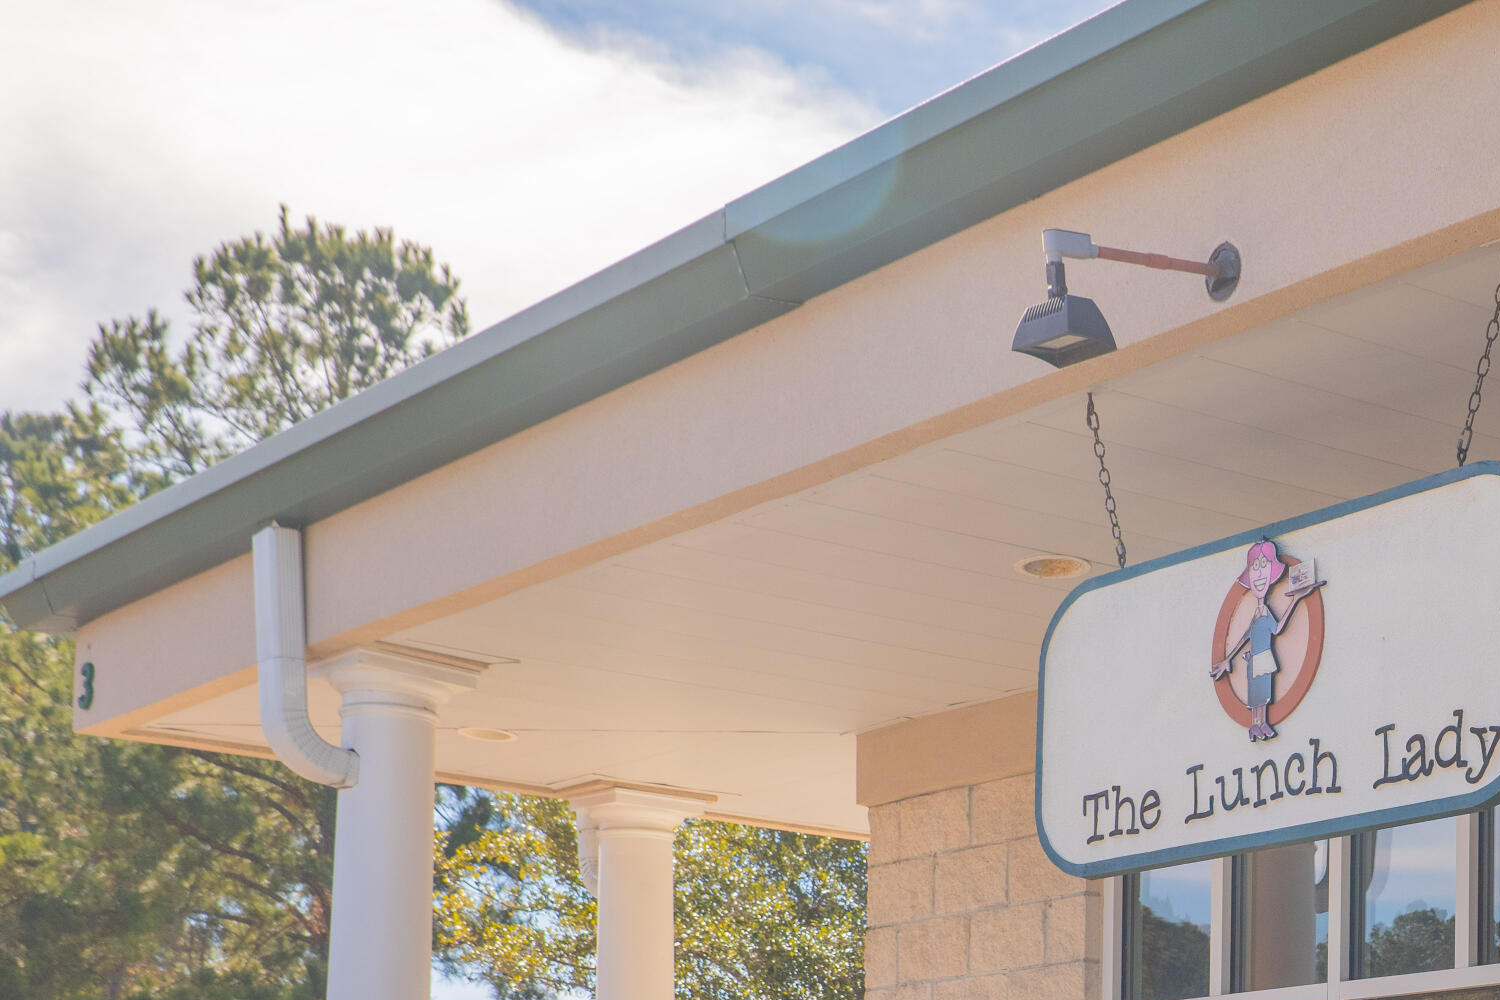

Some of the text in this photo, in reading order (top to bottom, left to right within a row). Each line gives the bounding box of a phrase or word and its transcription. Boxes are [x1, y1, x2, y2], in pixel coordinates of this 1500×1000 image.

[77, 661, 95, 711] 3
[1082, 786, 1162, 845] The
[1185, 738, 1341, 824] Lunch
